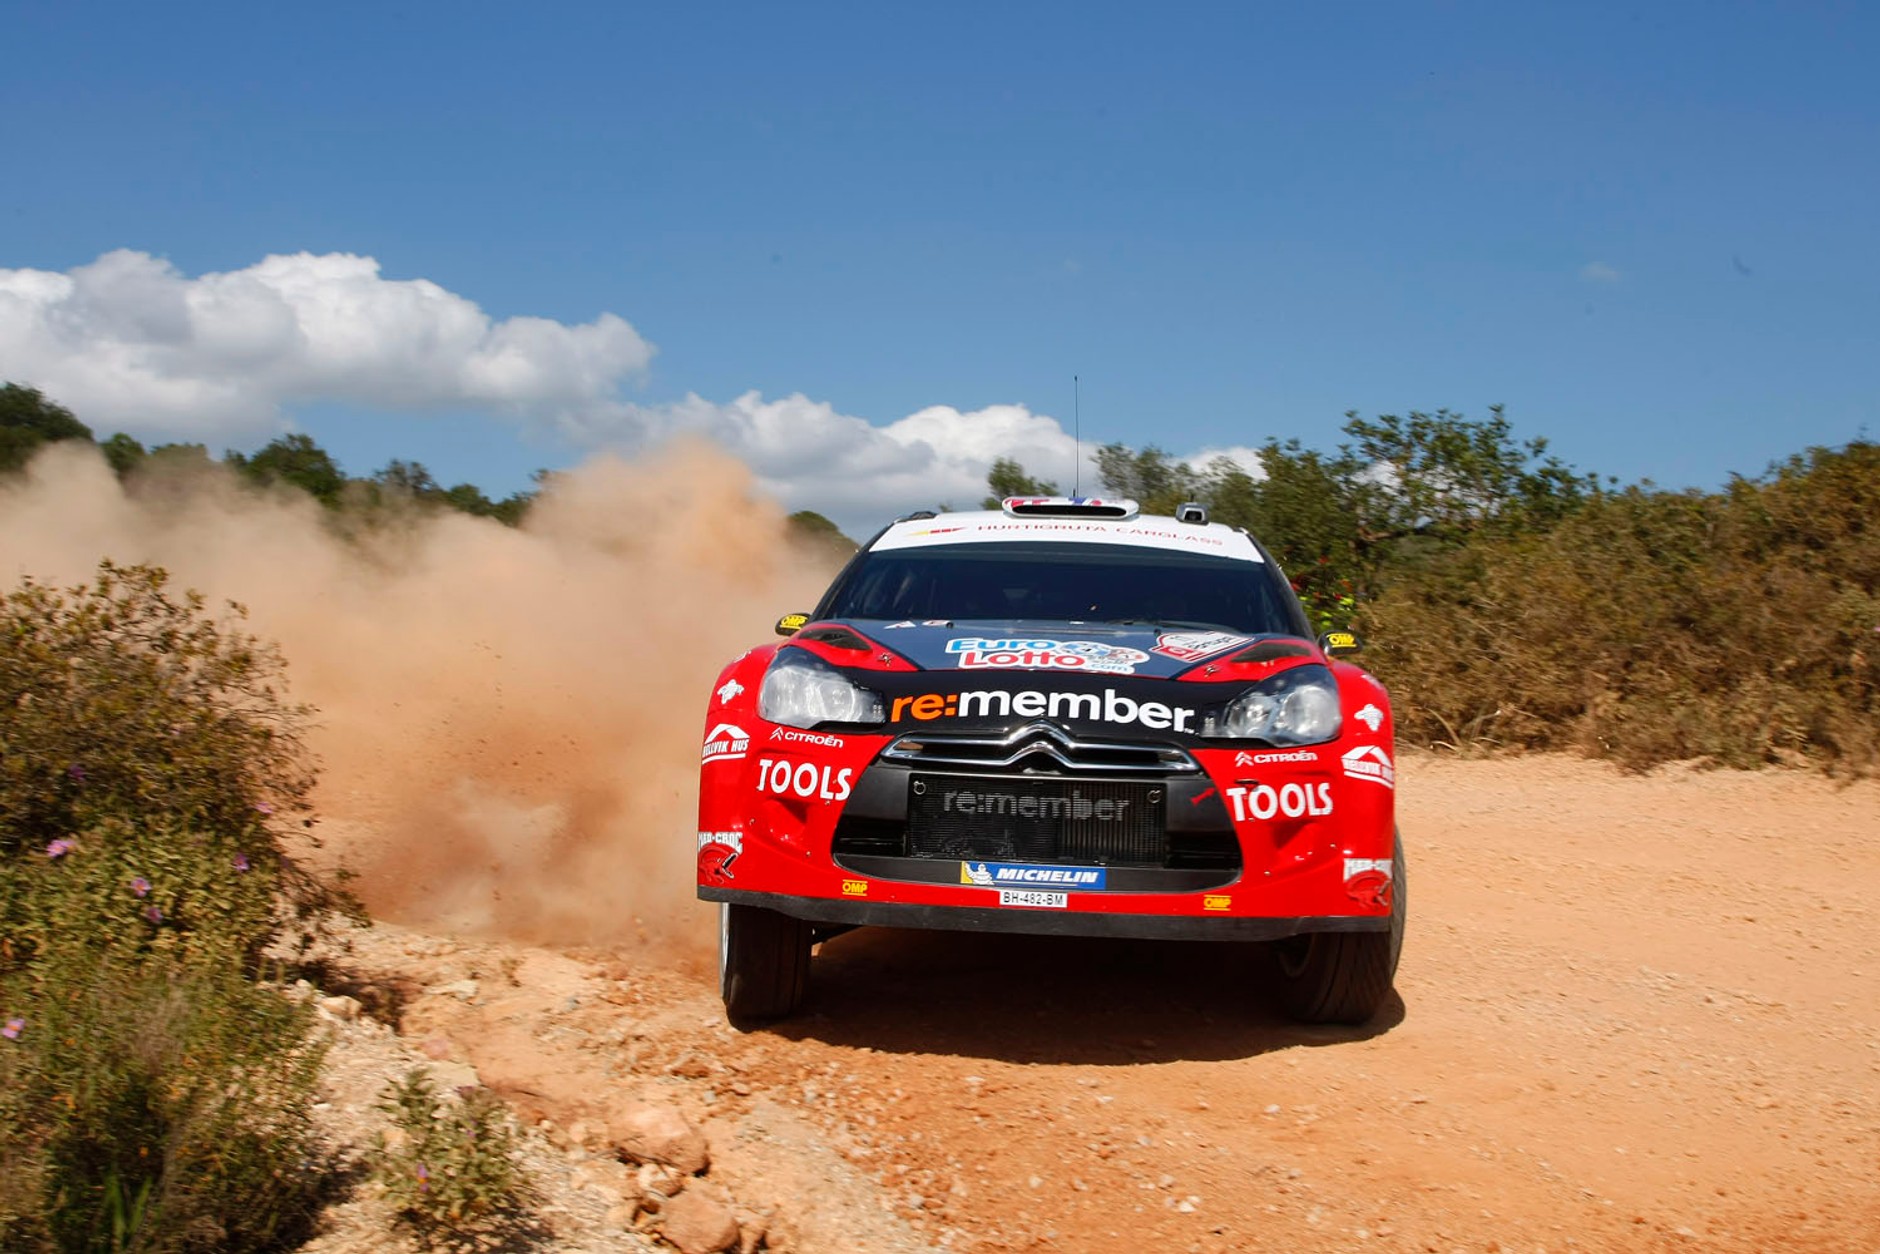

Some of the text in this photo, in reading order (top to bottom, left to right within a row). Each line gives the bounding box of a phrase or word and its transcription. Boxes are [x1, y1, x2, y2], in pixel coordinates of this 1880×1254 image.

[951, 640, 1056, 651] Euro
[964, 651, 1085, 666] Lotto
[890, 689, 1195, 732] re:member
[758, 758, 852, 801] TOOLS
[944, 790, 1130, 822] re:member
[1226, 782, 1334, 821] TOOLS
[996, 868, 1099, 883] MICHELIN
[842, 882, 868, 893] OMP
[1003, 891, 1064, 906] BH-482-BM
[1203, 897, 1232, 908] OMP
